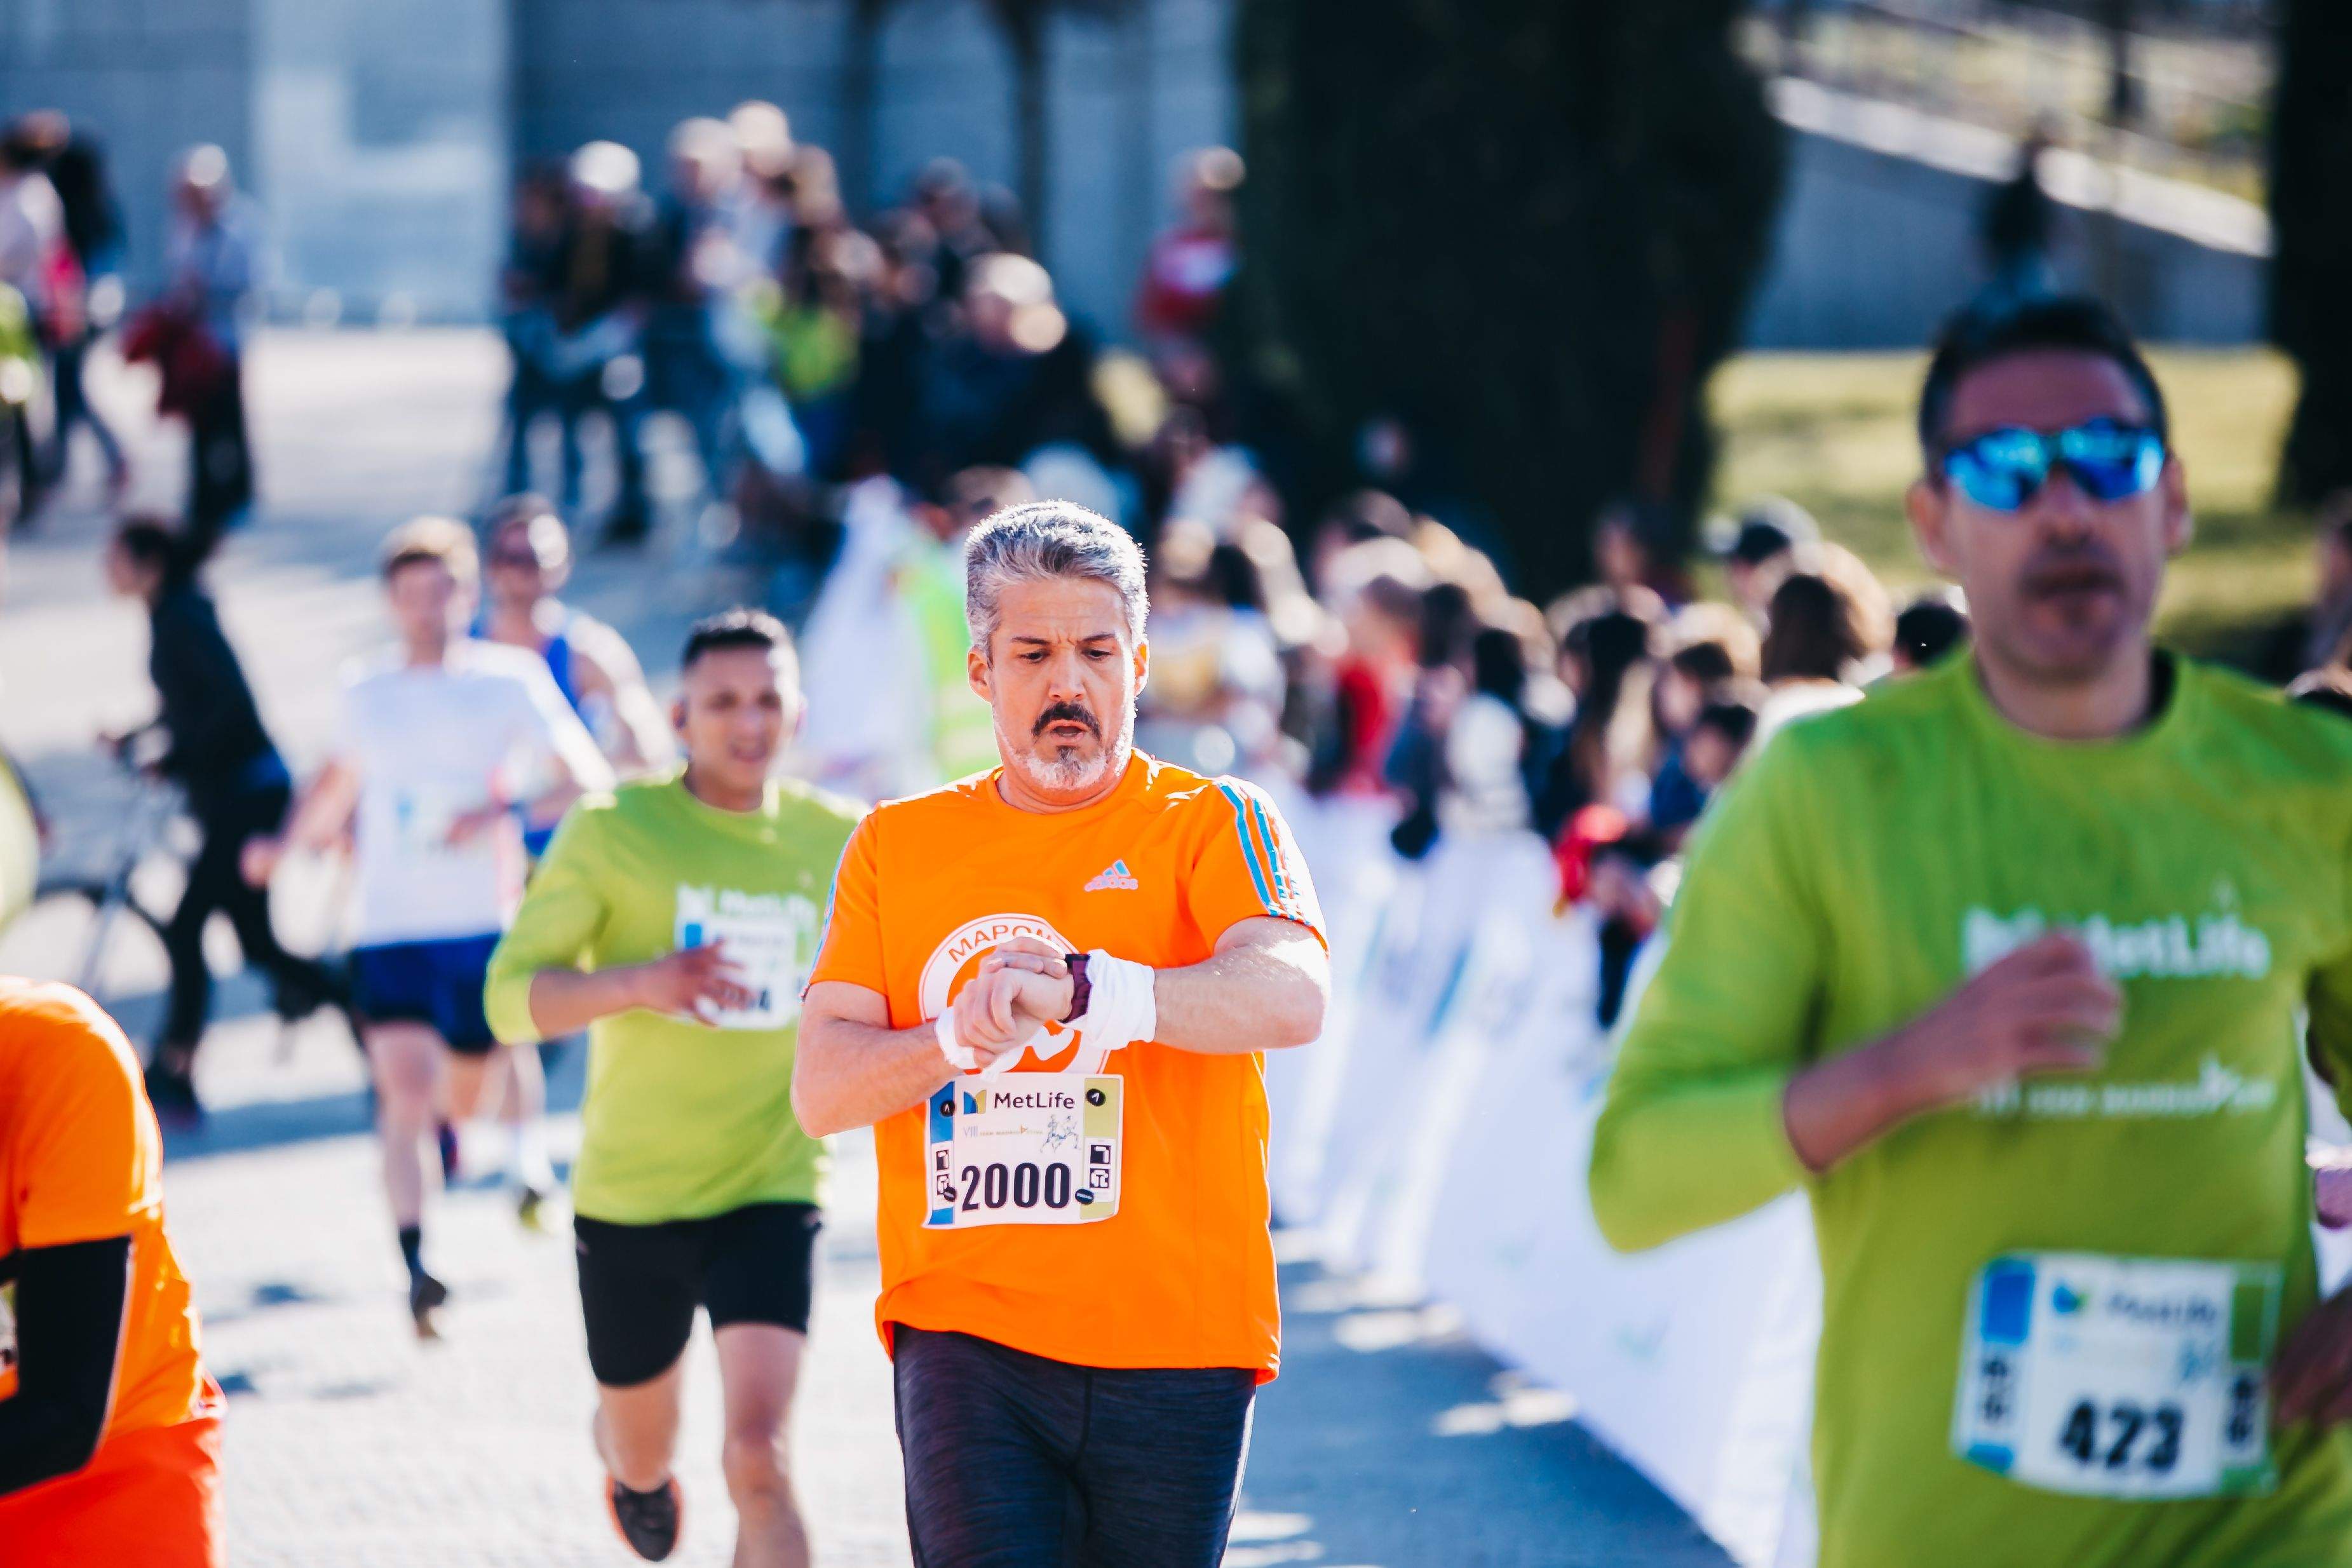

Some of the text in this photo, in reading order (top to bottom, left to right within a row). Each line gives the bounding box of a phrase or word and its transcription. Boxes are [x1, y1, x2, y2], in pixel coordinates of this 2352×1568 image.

[949, 924, 1052, 963] MAPO
[994, 1092, 1075, 1109] MetLife
[961, 1163, 1071, 1212] 2000
